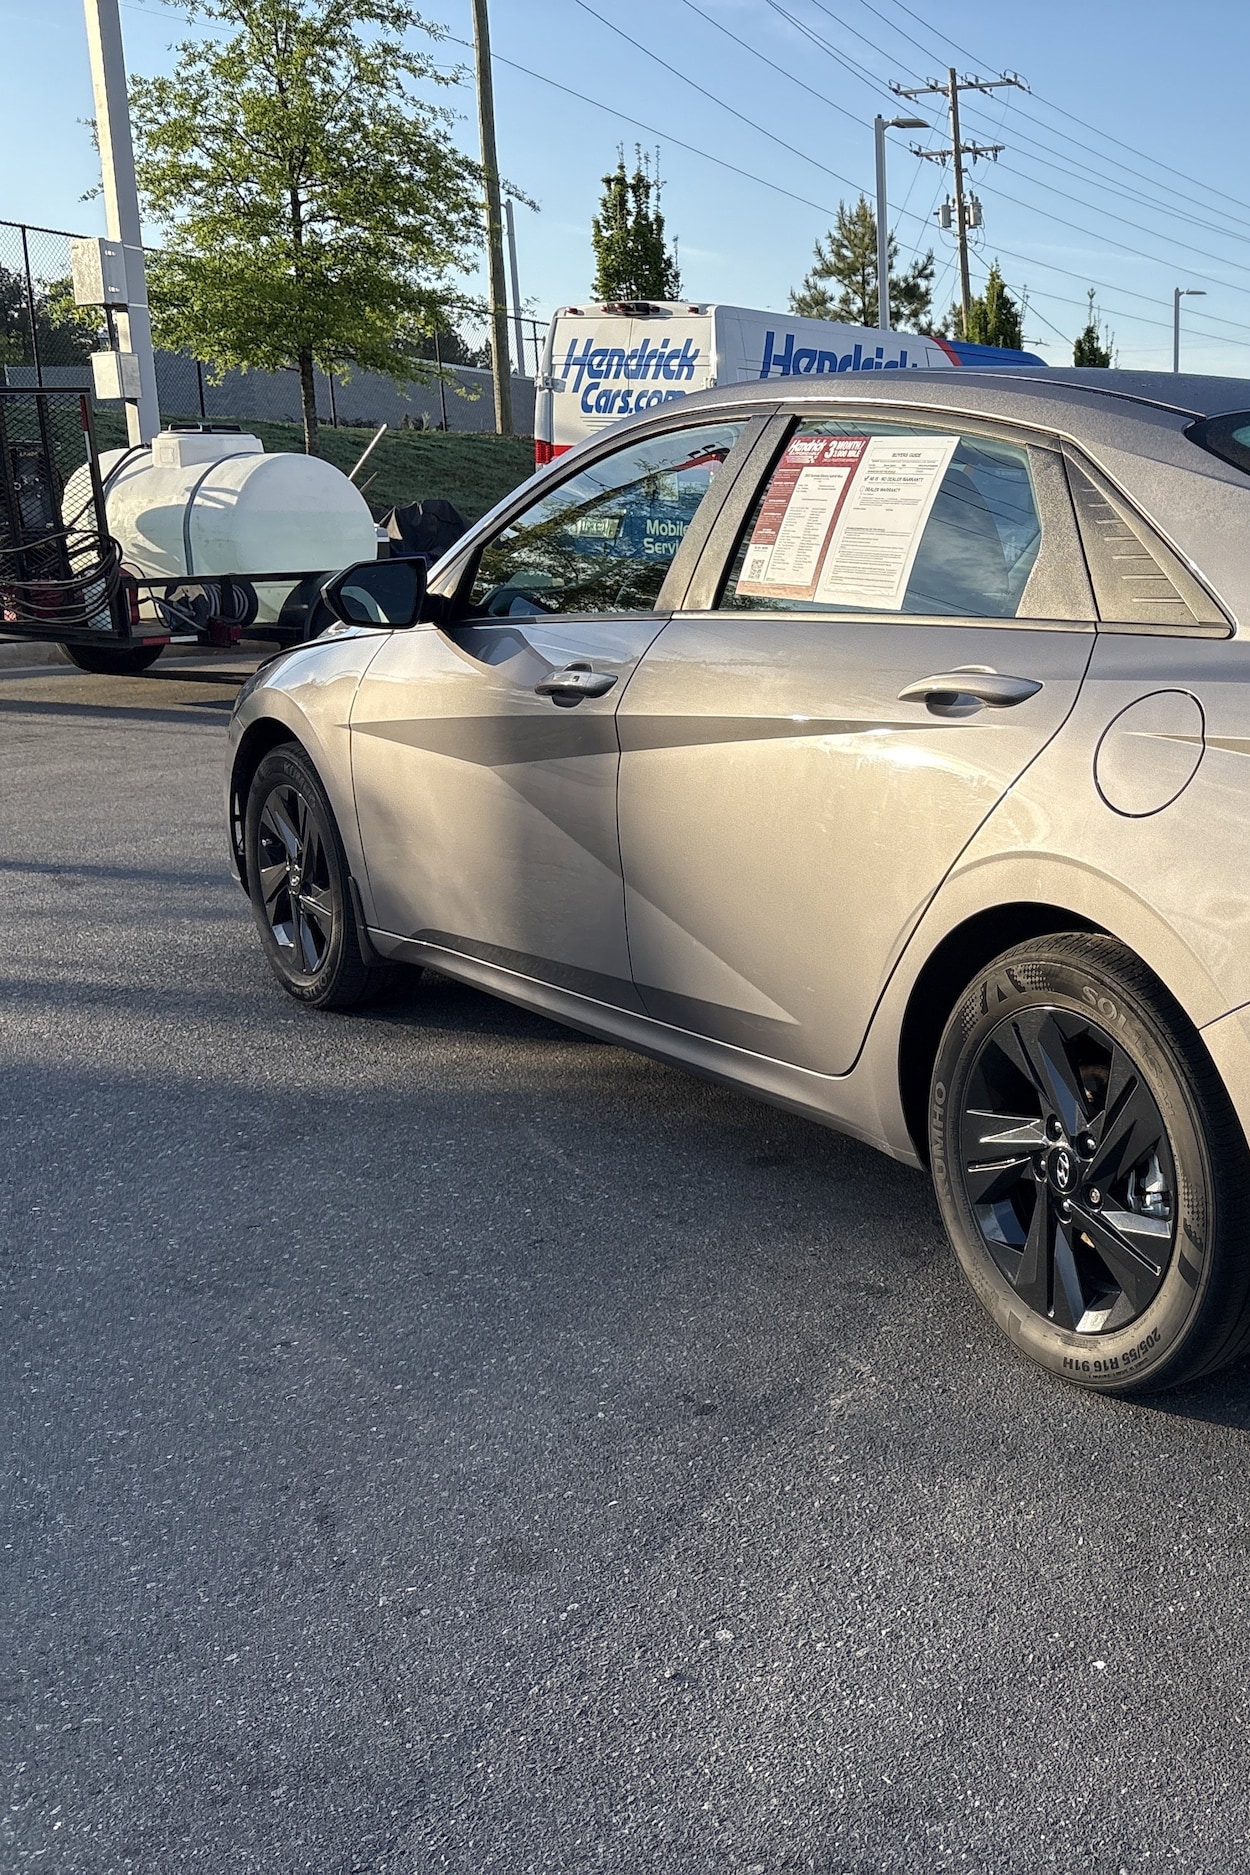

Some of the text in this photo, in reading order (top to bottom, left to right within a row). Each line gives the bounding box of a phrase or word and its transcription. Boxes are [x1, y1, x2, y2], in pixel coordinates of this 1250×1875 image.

[561, 338, 701, 393] Hendrick
[824, 441, 838, 459] 3
[646, 519, 689, 537] Mobile
[930, 1081, 953, 1204] KUMHO
[1121, 1326, 1161, 1366] 205/55
[1062, 1356, 1090, 1372] 91H
[1093, 1356, 1120, 1372] R16
